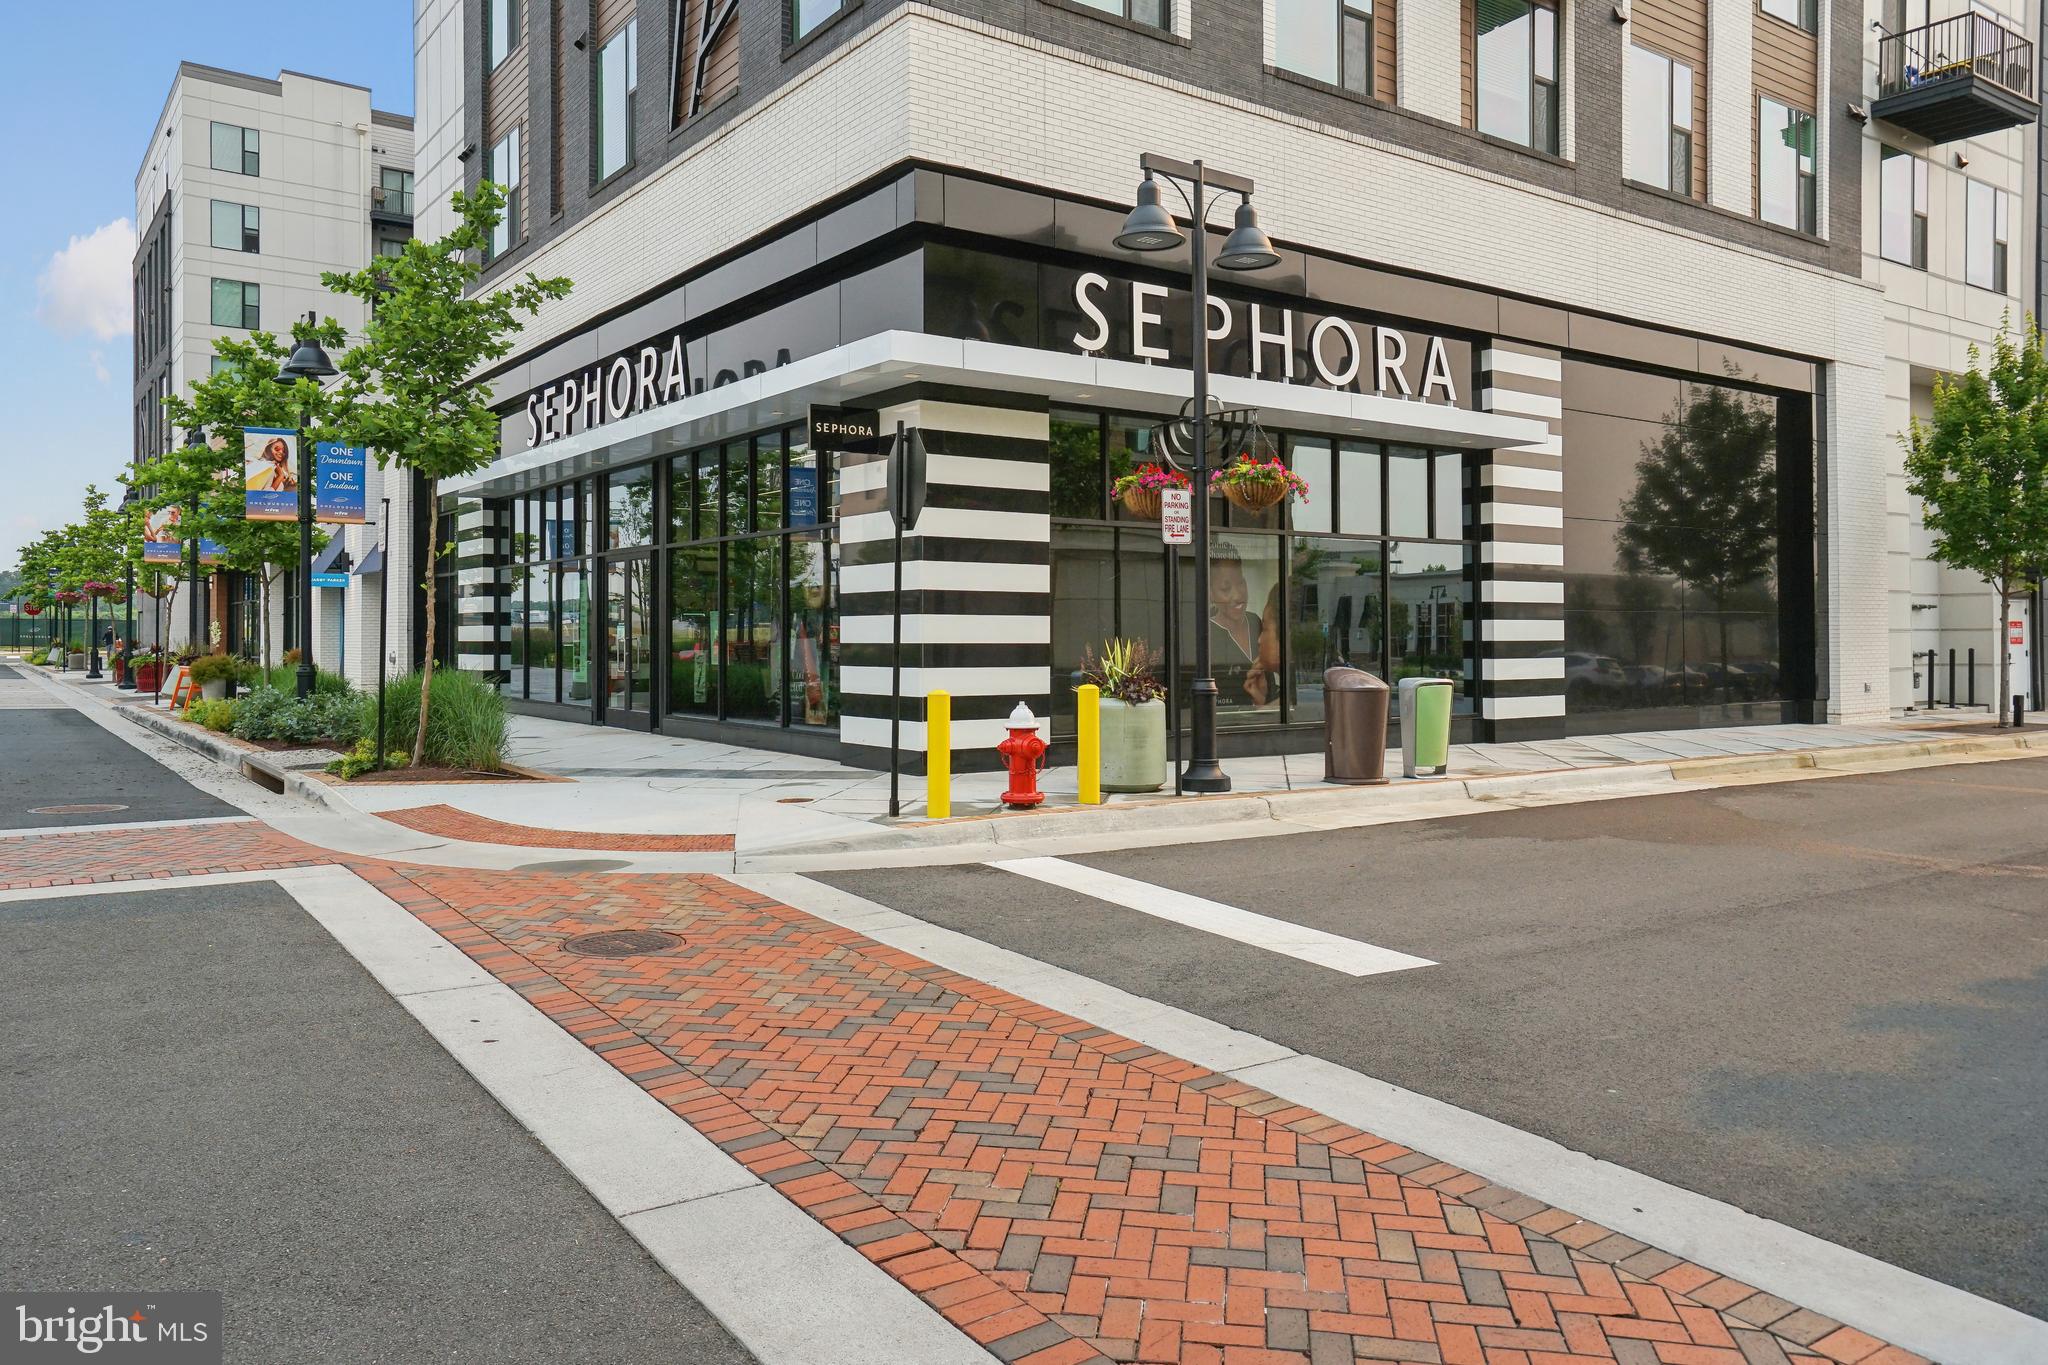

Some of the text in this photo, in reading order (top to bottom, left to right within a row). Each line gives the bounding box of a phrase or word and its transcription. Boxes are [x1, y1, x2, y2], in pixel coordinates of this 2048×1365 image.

[1073, 273, 1458, 401] SEPHORA
[527, 335, 689, 448] SEPHORA
[816, 422, 873, 436] SEPHORA
[330, 446, 353, 456] ONE
[320, 454, 364, 466] Downtown
[330, 471, 353, 481] ONE
[324, 480, 360, 491] Loudoun
[1164, 515, 1189, 523] STANDING
[1164, 524, 1189, 533] FIRE LANE
